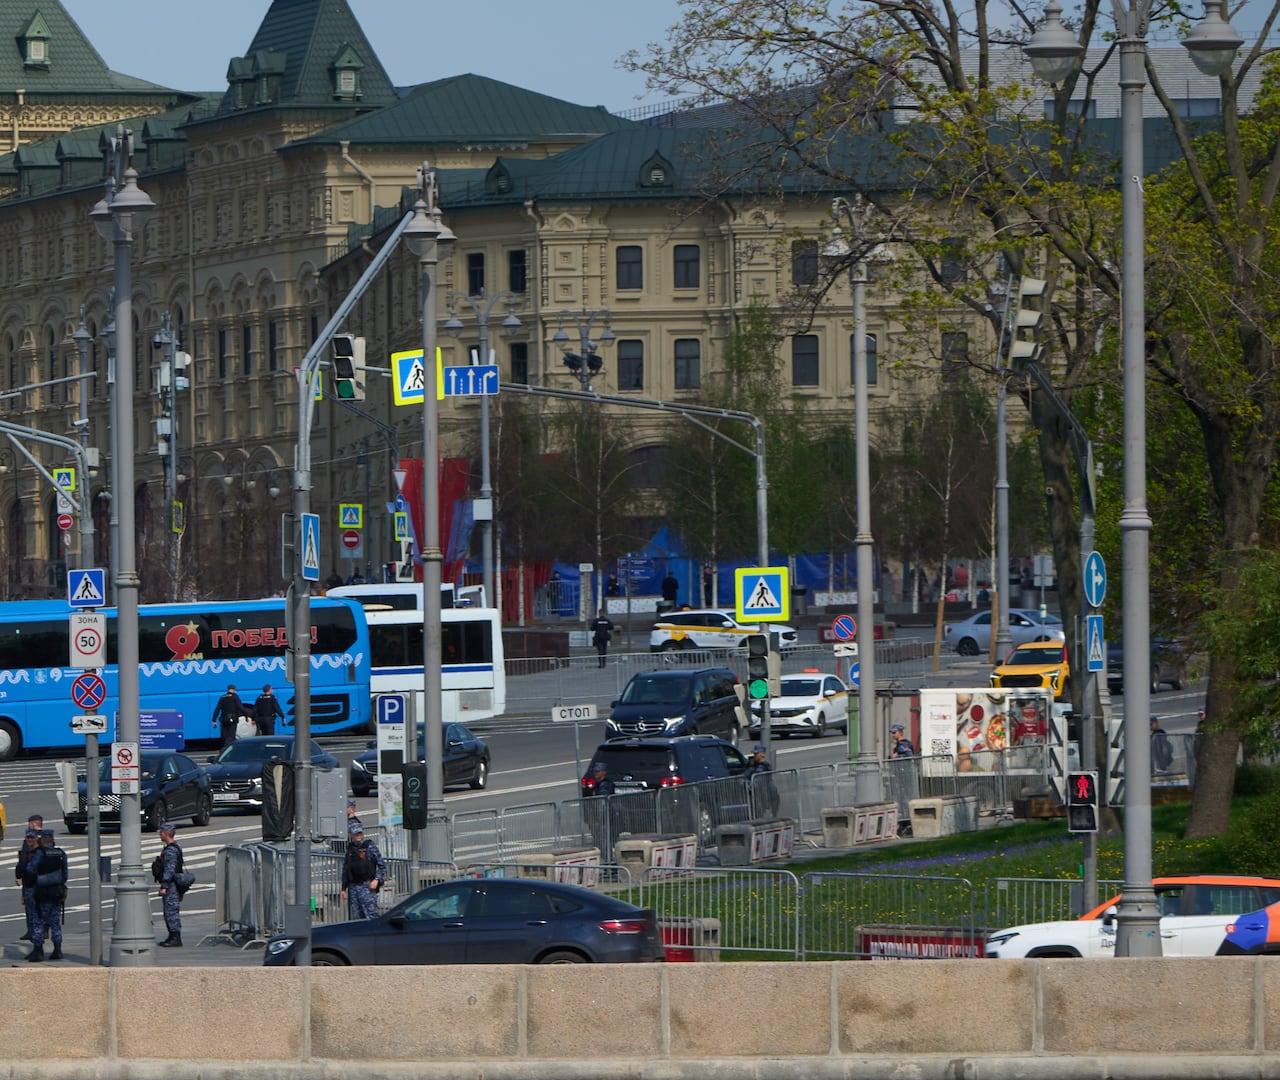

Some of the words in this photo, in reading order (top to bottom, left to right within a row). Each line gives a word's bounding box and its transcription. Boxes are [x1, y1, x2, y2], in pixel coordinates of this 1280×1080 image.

[78, 616, 99, 624] ЗОНА
[80, 636, 96, 647] 50
[211, 625, 318, 648] ПОБЕД!
[165, 624, 201, 661] 9
[184, 652, 204, 660] МАЯ
[560, 707, 590, 718] СТОП
